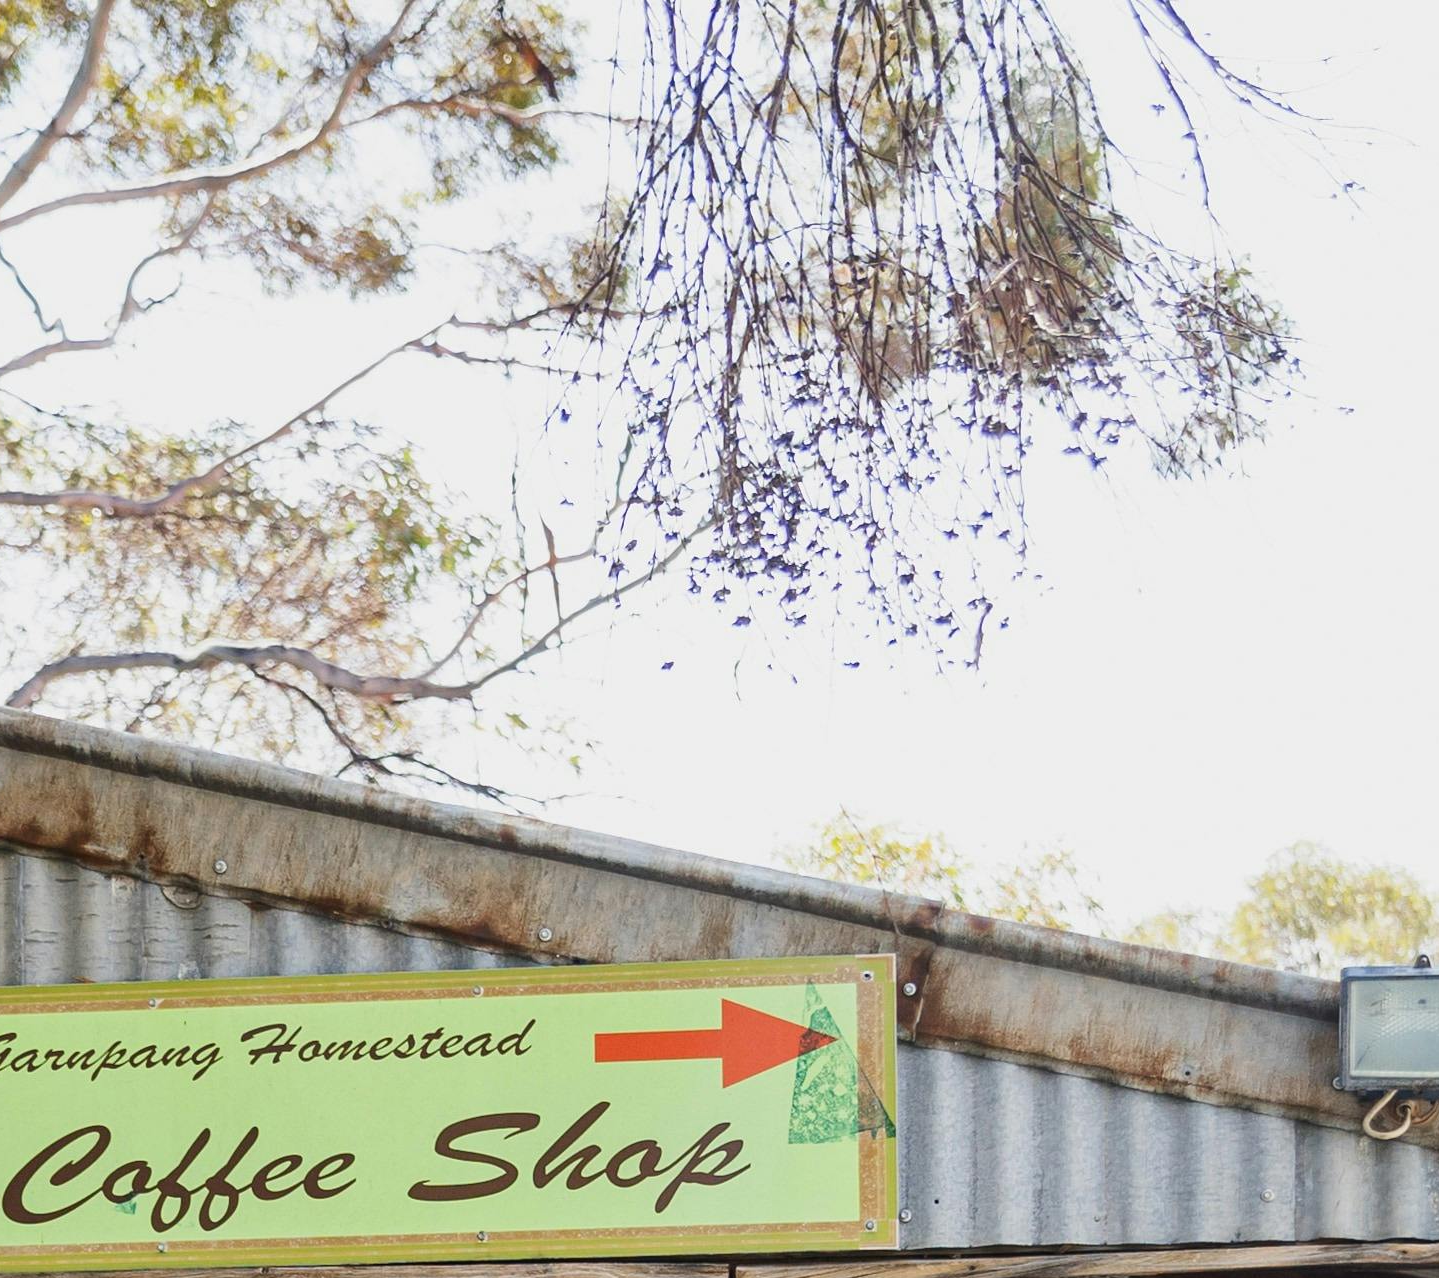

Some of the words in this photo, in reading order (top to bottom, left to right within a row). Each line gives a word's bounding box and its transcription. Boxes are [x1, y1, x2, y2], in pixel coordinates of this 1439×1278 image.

[240, 1019, 537, 1069] Homestead
[0, 1124, 358, 1233] Coffee
[407, 1101, 753, 1214] Shop
